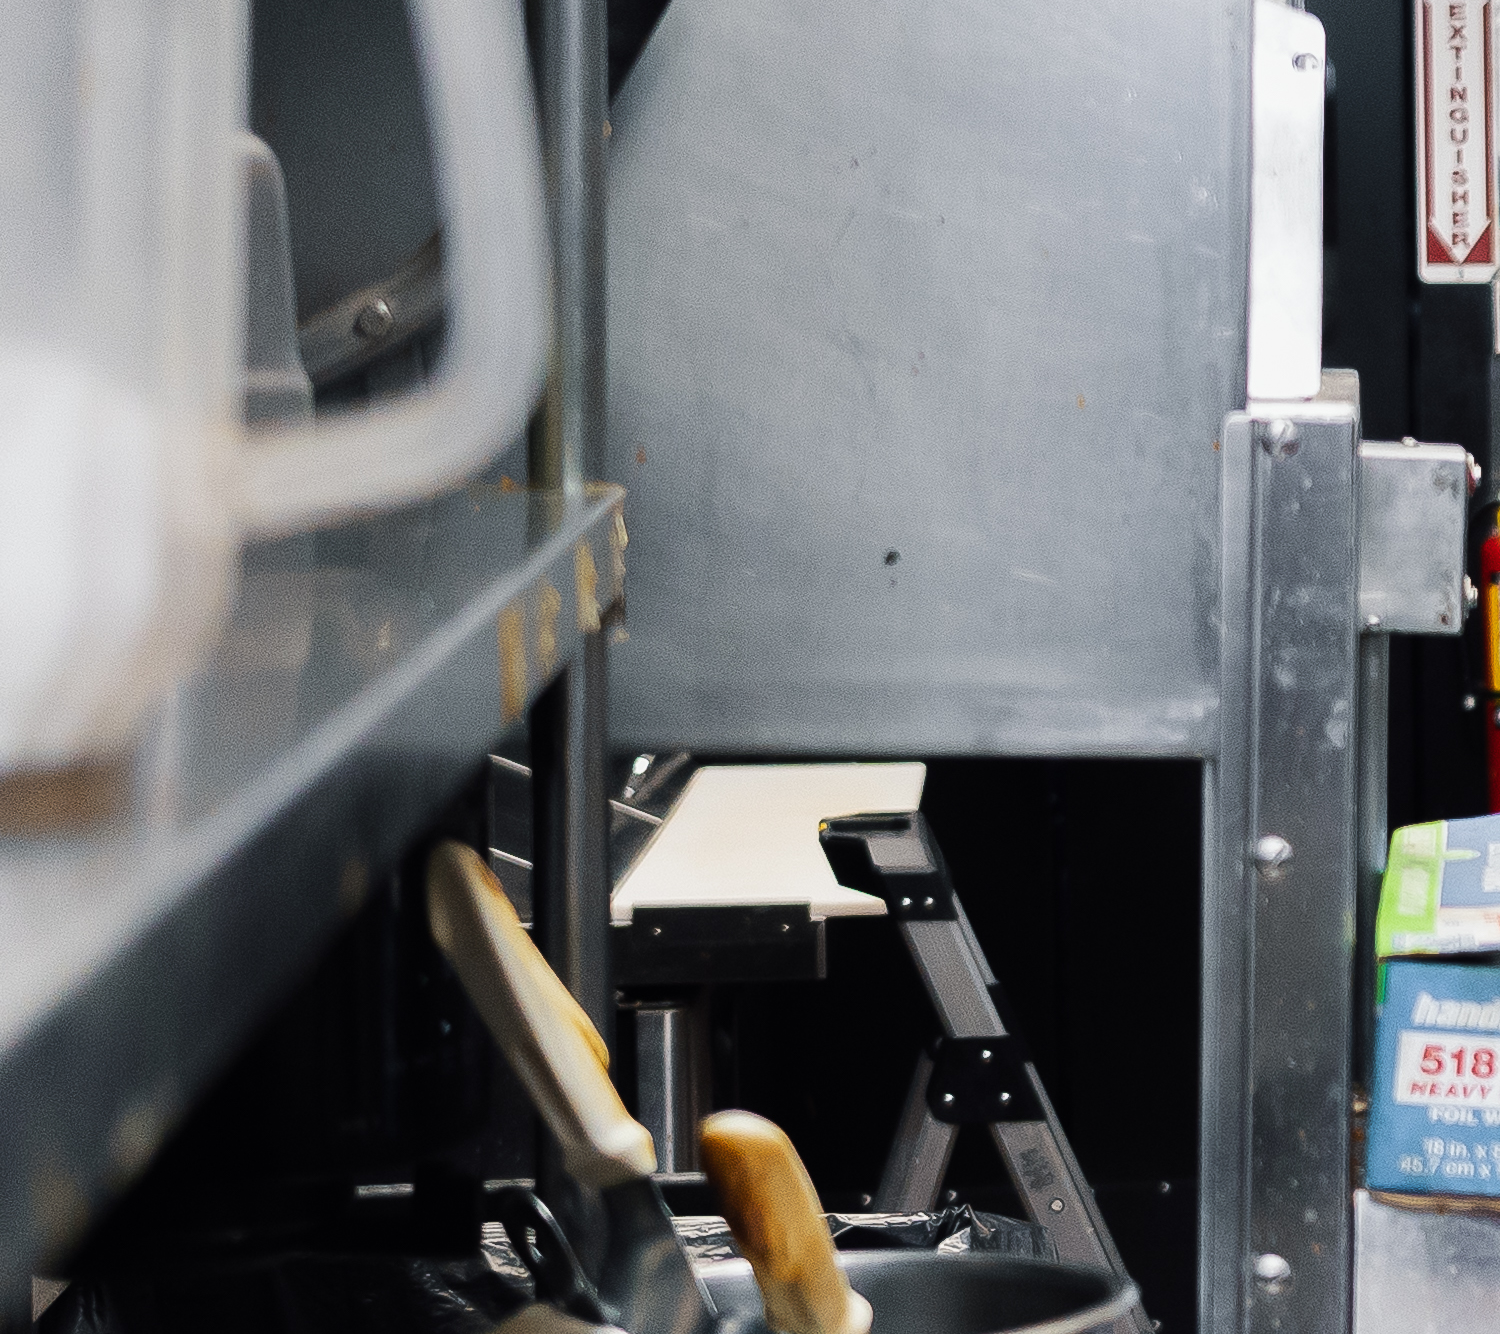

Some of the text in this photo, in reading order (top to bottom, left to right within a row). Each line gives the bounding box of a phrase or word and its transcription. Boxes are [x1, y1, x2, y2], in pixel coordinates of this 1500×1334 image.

[1448, 2, 1470, 247] EXTINGUISHER
[1410, 1081, 1492, 1101] HEAVY
[1427, 1105, 1479, 1127] FOIL
[1446, 1160, 1475, 1179] cm
